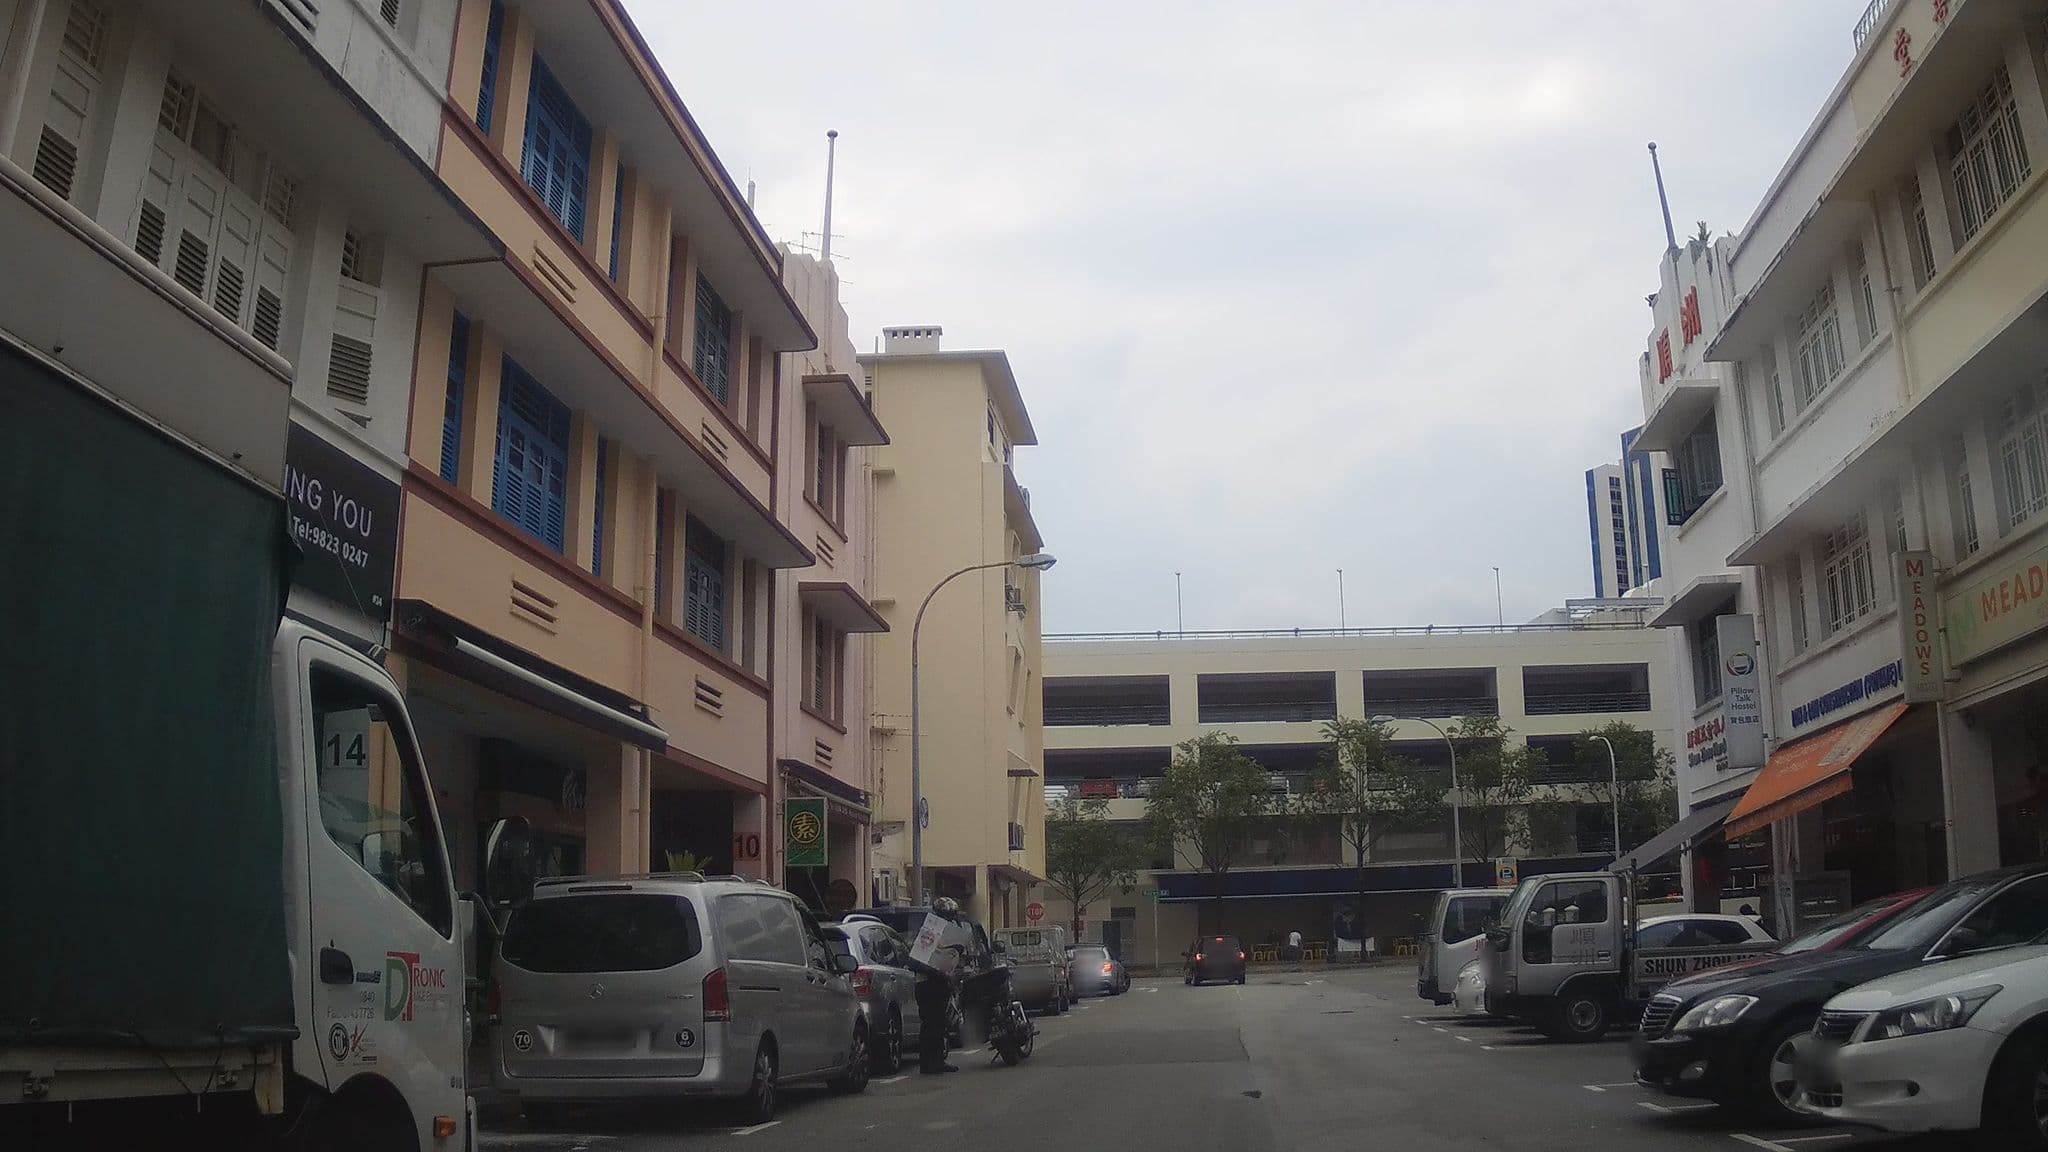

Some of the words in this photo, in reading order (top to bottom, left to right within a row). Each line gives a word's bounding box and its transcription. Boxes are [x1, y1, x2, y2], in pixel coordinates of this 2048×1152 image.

[332, 489, 372, 537] YOU
[292, 515, 340, 554] Tel:9823
[342, 541, 369, 568] 0247
[1980, 560, 2048, 623] MEAD
[1906, 558, 1932, 676] MEADOWS
[1730, 687, 1755, 695] Pillow
[1735, 694, 1751, 702] Talk
[1731, 701, 1757, 711] Hostel
[327, 733, 366, 766] 14
[793, 814, 816, 839] 素
[733, 834, 760, 858] 10
[1644, 957, 1687, 975] SHUN
[516, 1034, 531, 1046] 70
